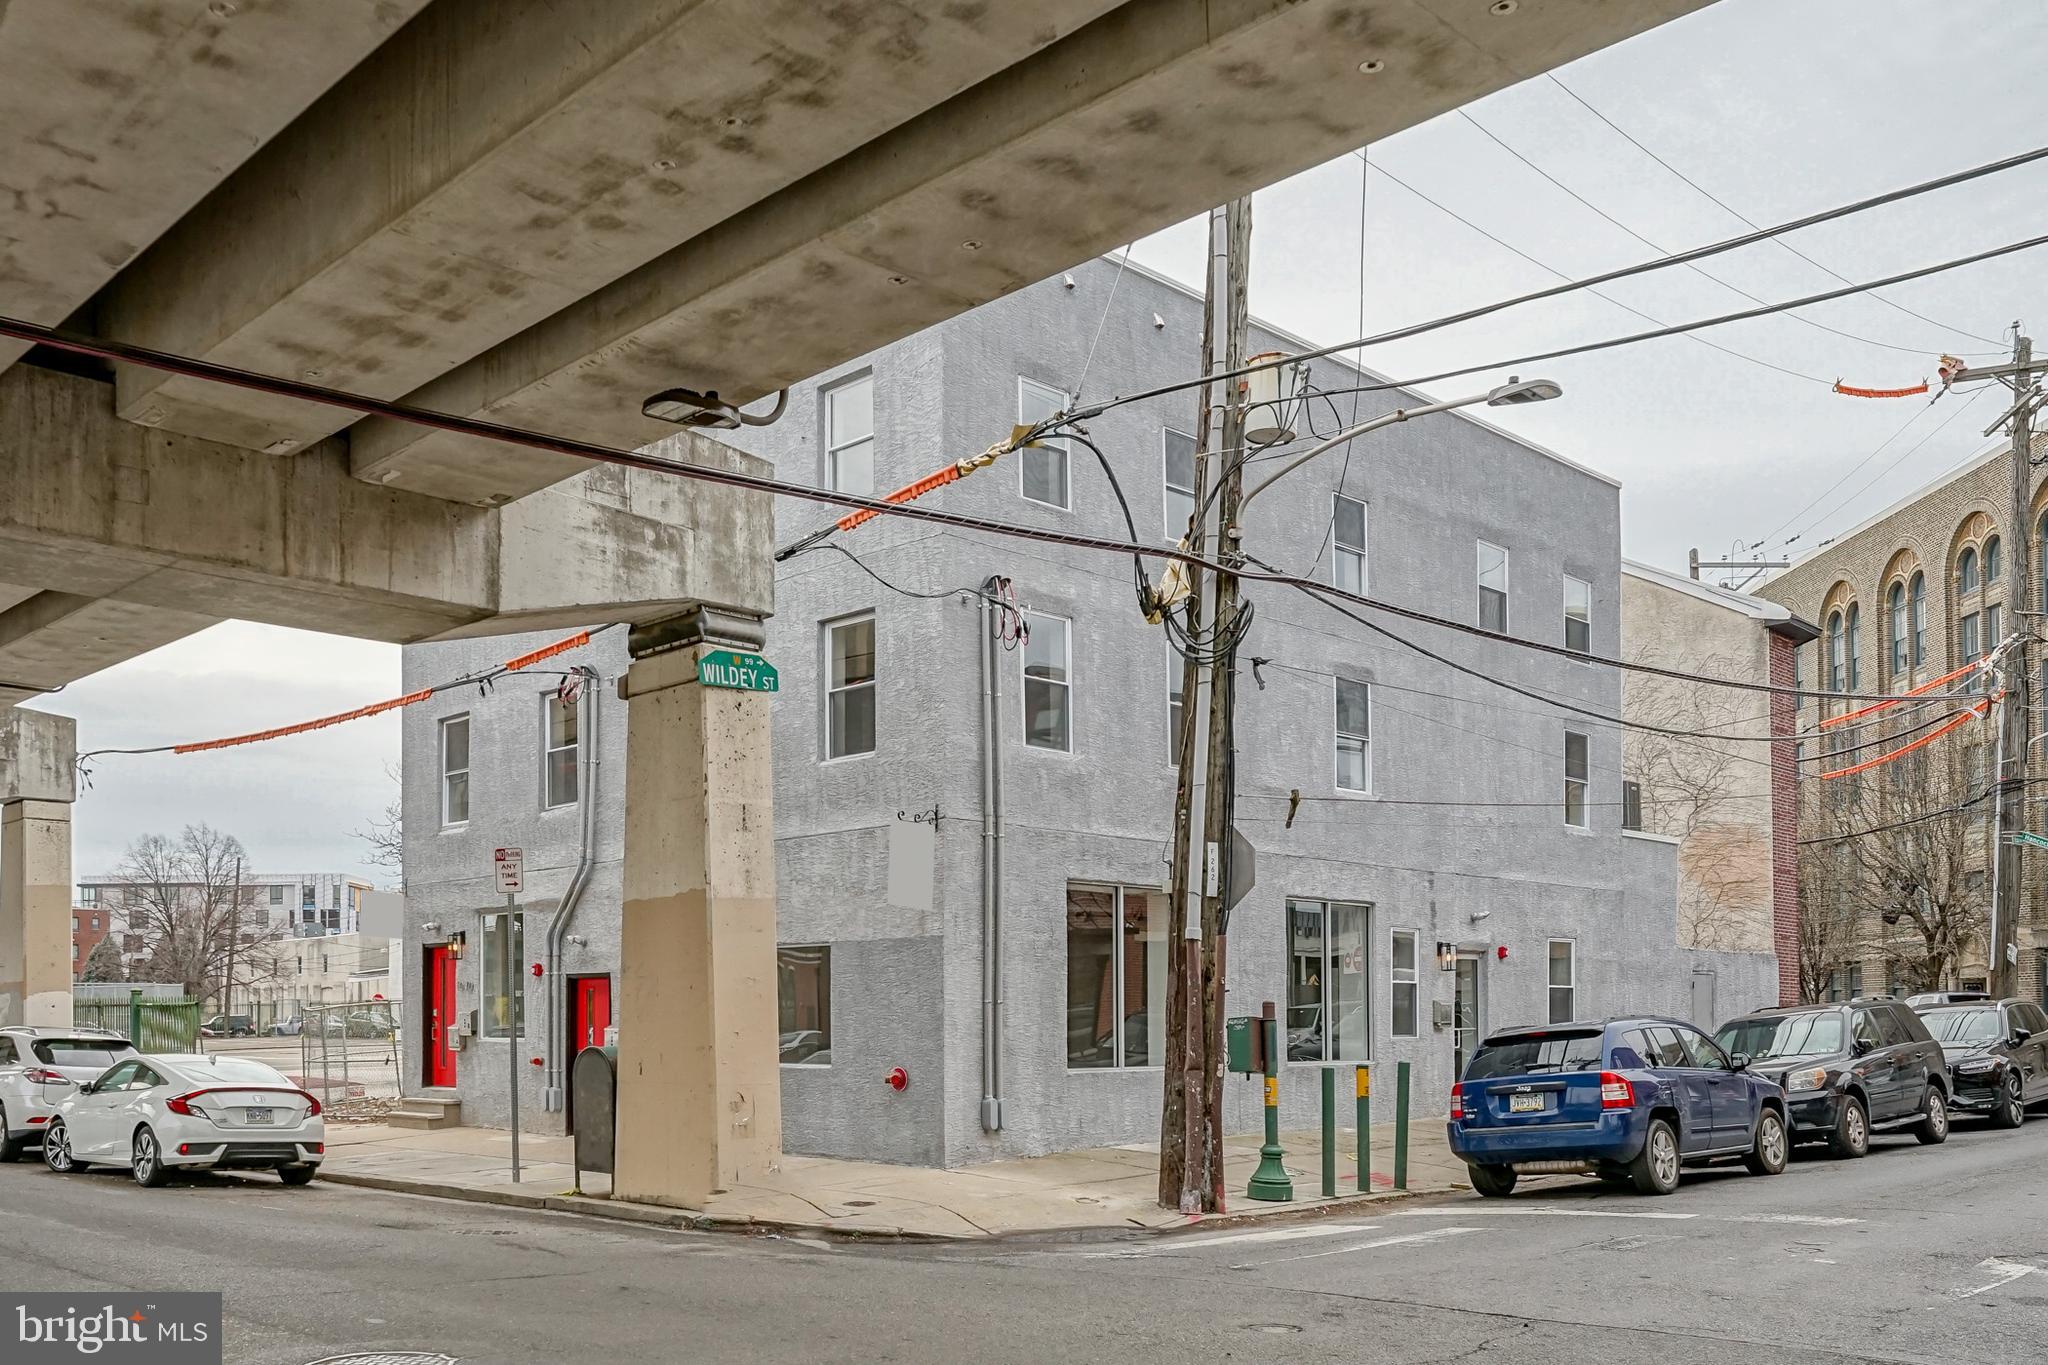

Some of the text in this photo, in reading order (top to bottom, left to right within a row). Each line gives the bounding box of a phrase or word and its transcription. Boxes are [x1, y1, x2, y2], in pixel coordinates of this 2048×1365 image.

[744, 658, 754, 666] 99
[702, 662, 775, 690] WILDEY ST
[2024, 835, 2048, 847] Hancoc
[496, 850, 504, 860] NO
